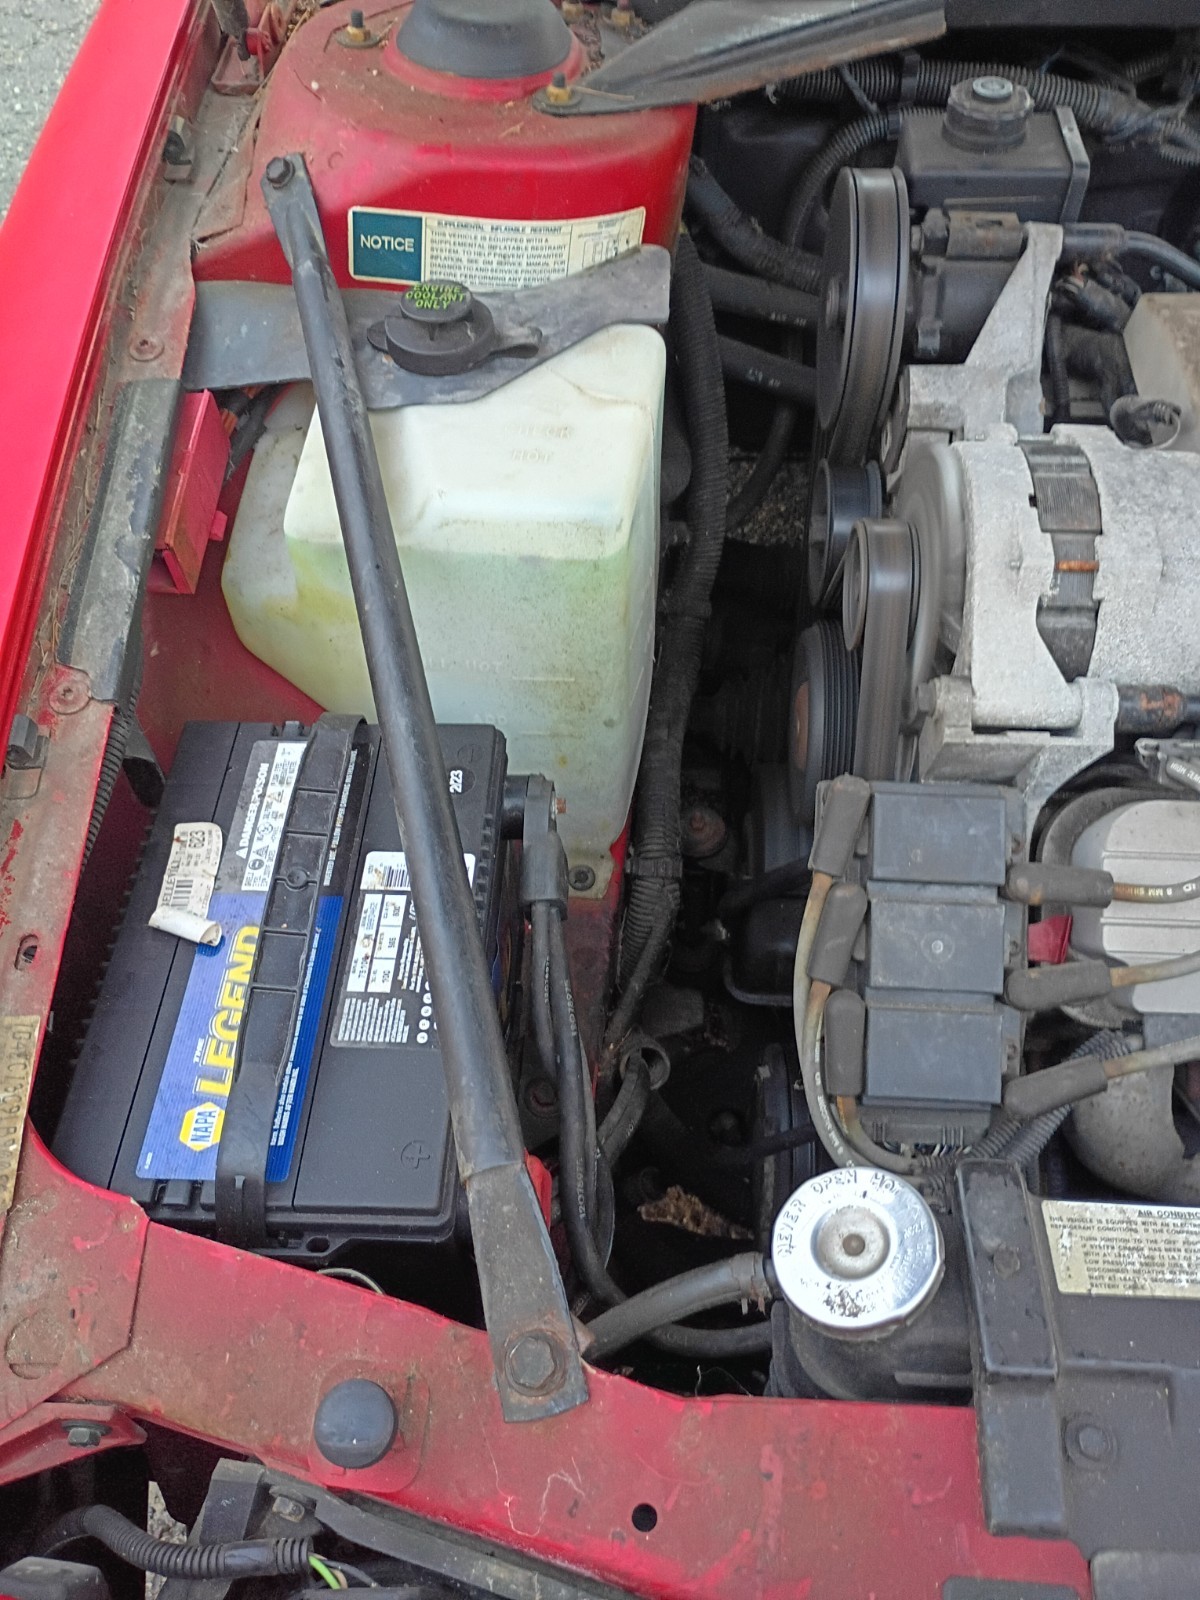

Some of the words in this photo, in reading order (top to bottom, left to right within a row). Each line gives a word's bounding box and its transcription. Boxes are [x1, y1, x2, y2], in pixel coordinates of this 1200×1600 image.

[437, 220, 484, 231] SUPPLEMENTAL
[448, 232, 478, 240] VEHICLE
[360, 233, 415, 253] NOTICE
[431, 238, 485, 249] SUPPLEMENTAL
[430, 262, 474, 272] DIAGNOSTIC
[430, 270, 457, 278] BEFORE
[460, 273, 506, 282] PERFORMING
[405, 291, 465, 303] COOLANT
[415, 299, 449, 310] ONLY
[511, 450, 554, 463] HOT
[450, 769, 463, 793] 2/23
[335, 806, 345, 827] PROPER
[189, 829, 205, 849] 623
[192, 924, 260, 1097] LEGEND
[193, 1037, 205, 1062] THE
[190, 1109, 217, 1143] NAPA
[576, 1156, 586, 1218] 12078975
[776, 1198, 806, 1259] NEVER
[810, 1168, 858, 1196] OPEN
[1137, 1209, 1153, 1217] AIR
[1049, 1215, 1063, 1223] THIS
[1066, 1216, 1093, 1224] VEHICLE
[1105, 1219, 1138, 1227] EQUIPPED
[1141, 1220, 1157, 1228] WITH
[1050, 1223, 1095, 1231] REFRIGERANT
[1102, 1259, 1136, 1267] PRESSURE
